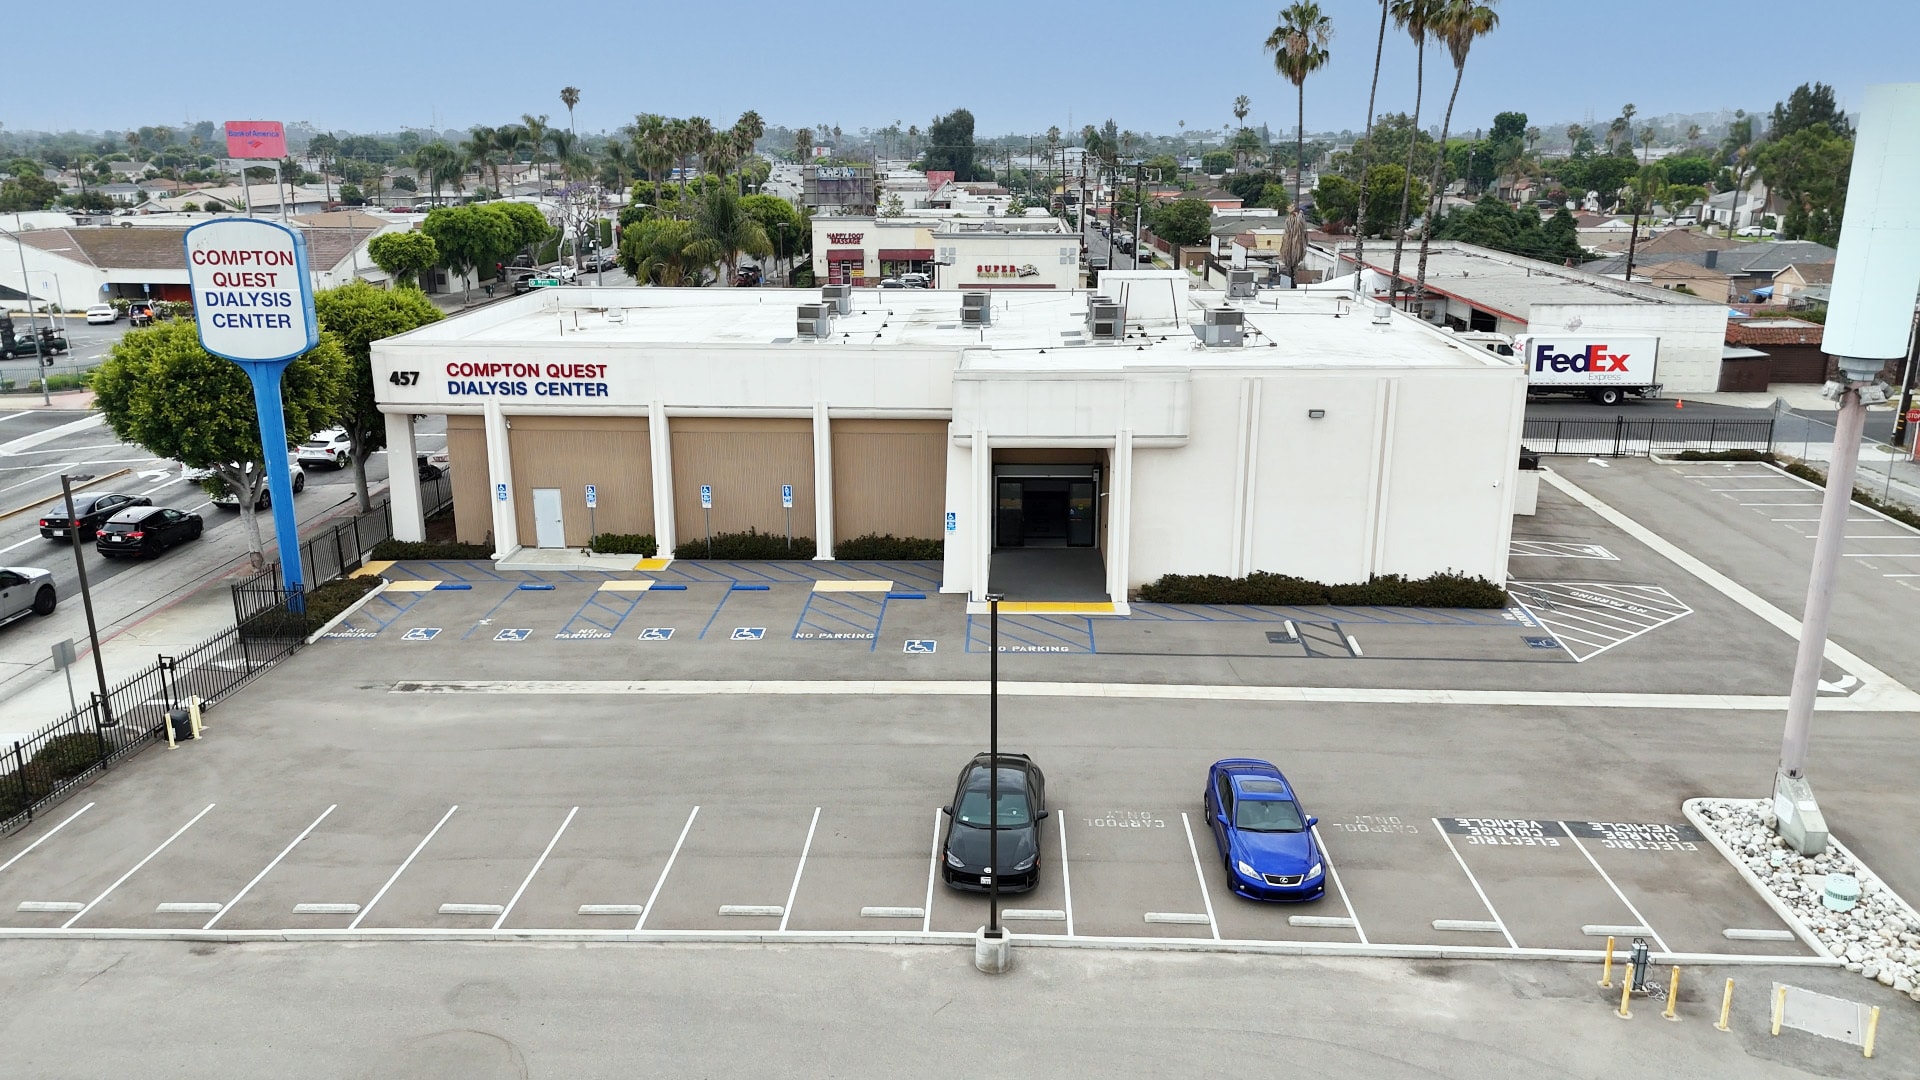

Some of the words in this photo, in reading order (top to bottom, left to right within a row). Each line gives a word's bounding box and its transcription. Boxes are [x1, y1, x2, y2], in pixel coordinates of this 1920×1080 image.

[192, 250, 294, 266] COMPTON
[212, 272, 278, 288] QUEST
[205, 292, 292, 307] DIALYSIS
[212, 313, 292, 329] CENTER
[1535, 345, 1631, 373] FedEx
[446, 362, 540, 378] COMPTON
[546, 363, 608, 379] QUEST
[389, 371, 420, 386] 457
[1588, 373, 1622, 381] Express
[448, 381, 528, 396] DIALYSIS
[534, 381, 609, 397] CENTER
[1106, 810, 1151, 820] ONLY
[1355, 815, 1401, 825] ONLY
[1082, 818, 1165, 828] CARPOOL
[1454, 818, 1544, 829] VEHICLE
[1587, 822, 1680, 833] VEHICLE
[1467, 826, 1544, 837] CHARGE
[1601, 830, 1680, 842] CHARGE
[1468, 835, 1560, 847] ELECTRIC
[1601, 839, 1698, 851] ELECTRIC
